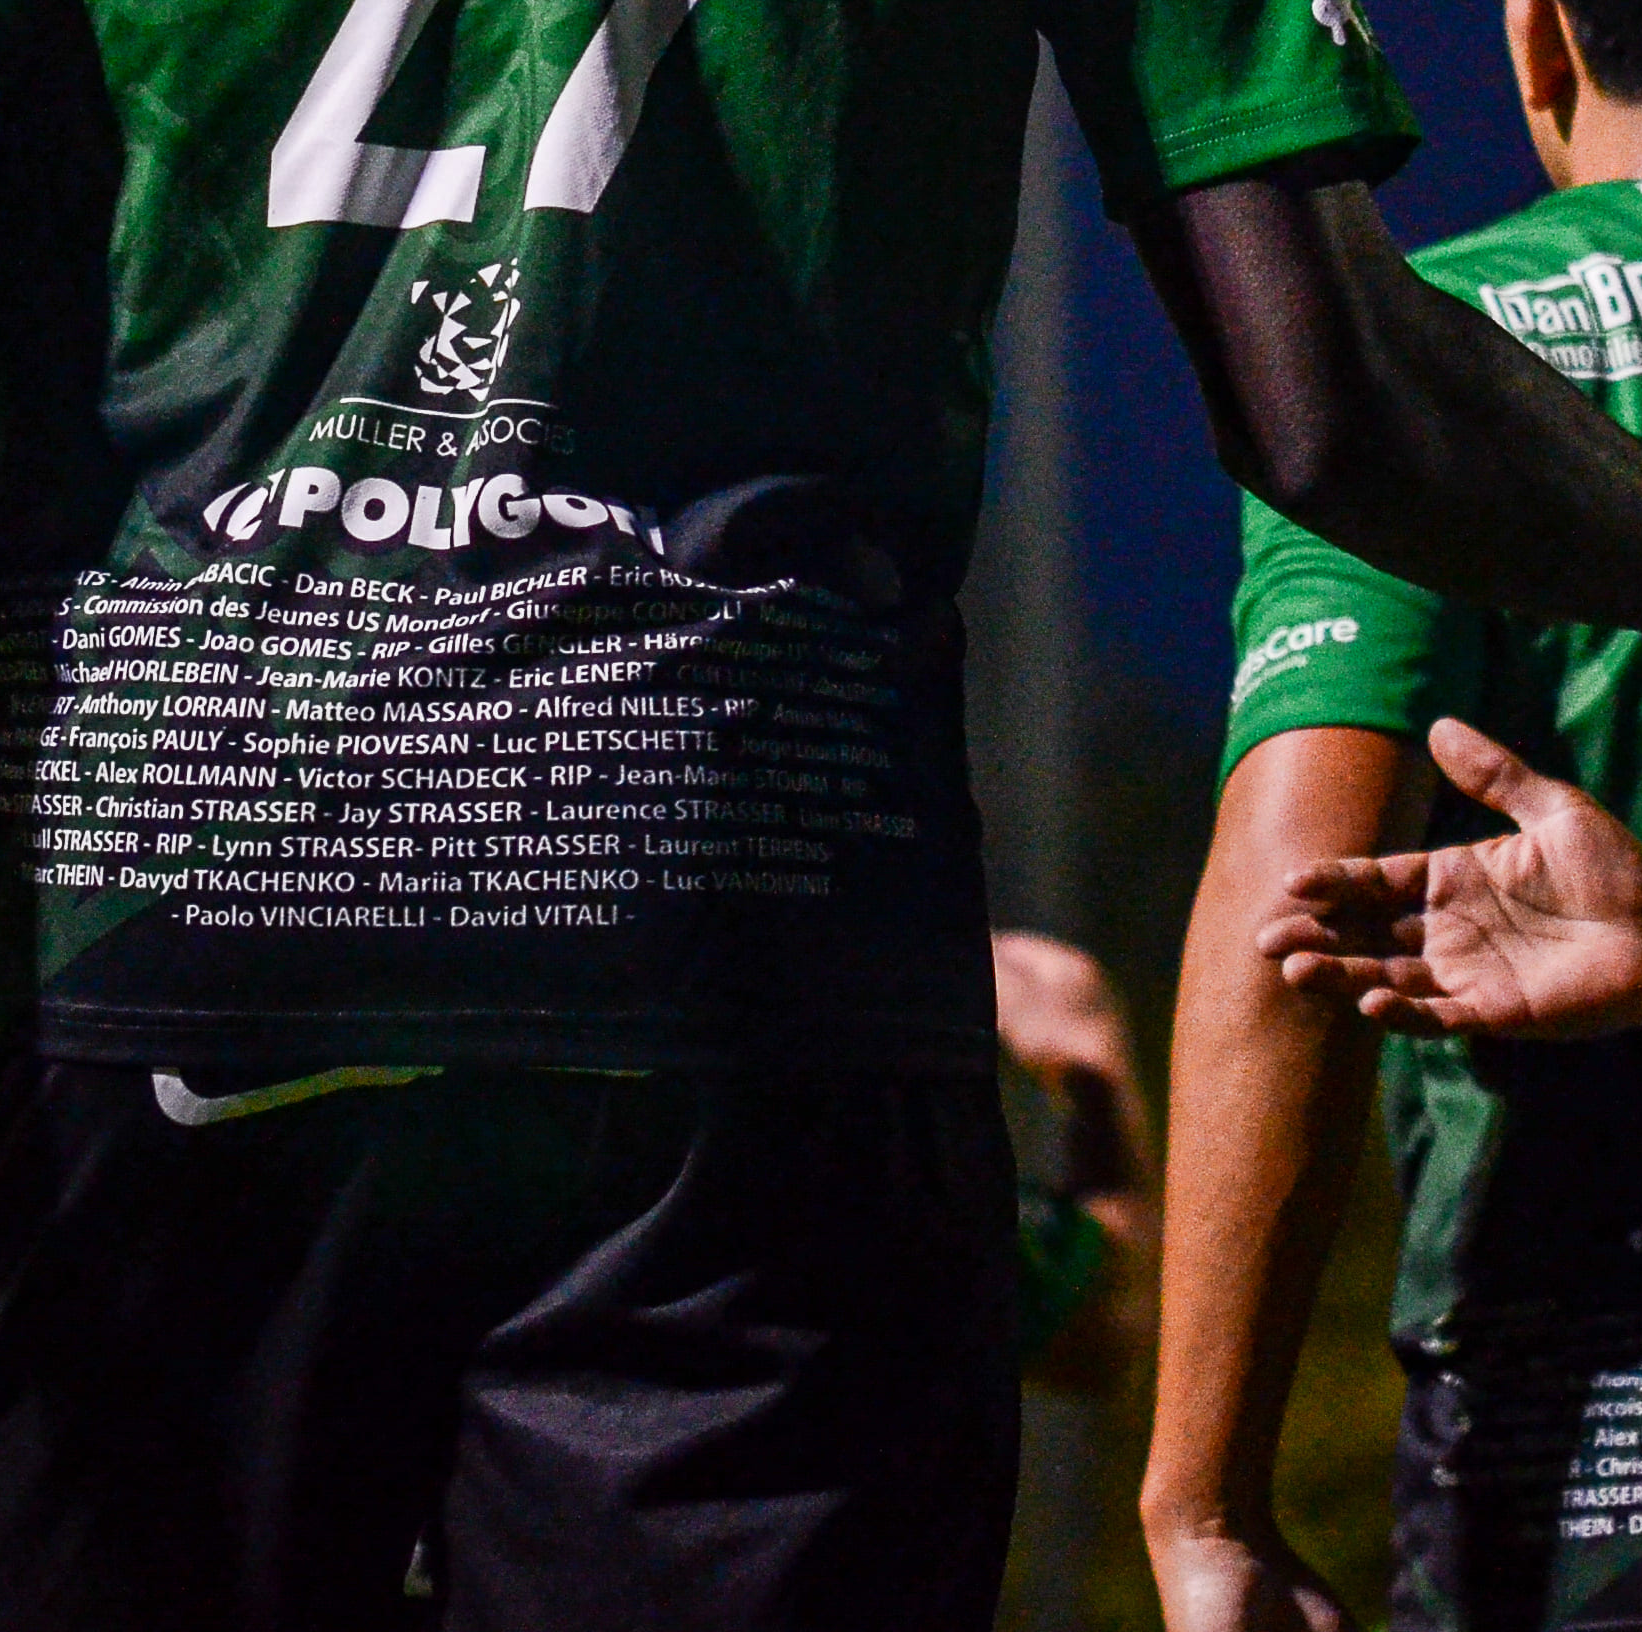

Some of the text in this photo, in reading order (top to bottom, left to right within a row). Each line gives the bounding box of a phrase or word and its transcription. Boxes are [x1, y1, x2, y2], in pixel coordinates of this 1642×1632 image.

[308, 414, 426, 453] MULLER
[436, 434, 458, 457] &
[295, 573, 344, 597] Dan
[350, 578, 415, 605] BECK
[434, 585, 486, 607] Paul
[490, 567, 588, 601] BICHLER
[609, 565, 654, 589] Eric
[83, 595, 203, 616] Commission
[209, 597, 250, 618] des
[255, 599, 339, 628] Jeunes
[346, 610, 380, 632] US
[384, 608, 491, 633] Mondorf
[62, 628, 105, 649] Dani
[108, 626, 182, 649] GOMES
[198, 630, 254, 653] Joao
[260, 635, 353, 661] GOMES
[371, 641, 410, 661] RIP
[428, 634, 496, 655] Gilles
[111, 660, 239, 685] HORLEBEIN
[255, 666, 390, 689] Jean-Marie
[397, 667, 487, 689] KONTZ
[509, 667, 554, 689] Eric
[560, 661, 658, 685] LENERT
[79, 694, 158, 721] Anthony
[162, 696, 266, 719] LORRAIN
[286, 699, 375, 723] Matteo
[382, 700, 513, 722] MASSARO
[535, 696, 613, 719] Alfred
[620, 696, 705, 718] NILLES
[724, 698, 760, 718] RIP
[68, 726, 148, 752] François
[152, 729, 225, 752] PAULY
[242, 732, 330, 757] Sophie
[336, 733, 470, 755] PIOVESAN
[493, 732, 537, 754] Luc
[544, 729, 720, 753] PLETSCHETTE
[27, 760, 81, 783] ECKEL
[95, 762, 138, 784] Alex
[142, 764, 277, 788] ROLLMANN
[299, 767, 375, 790] Victor
[381, 767, 528, 790] SCHADECK
[550, 765, 593, 787] RIP
[95, 795, 184, 820] Christian
[190, 798, 316, 823] STRASSER
[338, 802, 382, 829] Jay
[388, 802, 523, 824] STRASSER
[546, 799, 668, 822] Laurence
[54, 831, 139, 854] STRASSER
[156, 832, 192, 855] RIP
[212, 835, 273, 861] Lynn
[431, 836, 477, 858] Pitt
[484, 834, 620, 858] STRASSER
[645, 834, 741, 856] Laurent
[57, 864, 104, 887] THEIN
[120, 867, 189, 895] Davyd
[195, 870, 356, 893] TKACHENKO
[379, 870, 462, 893] Mariia
[468, 869, 640, 892] TKACHENKO
[663, 868, 707, 892] Luc
[185, 904, 619, 928] Paolo VINCIARELLI David VITALI
